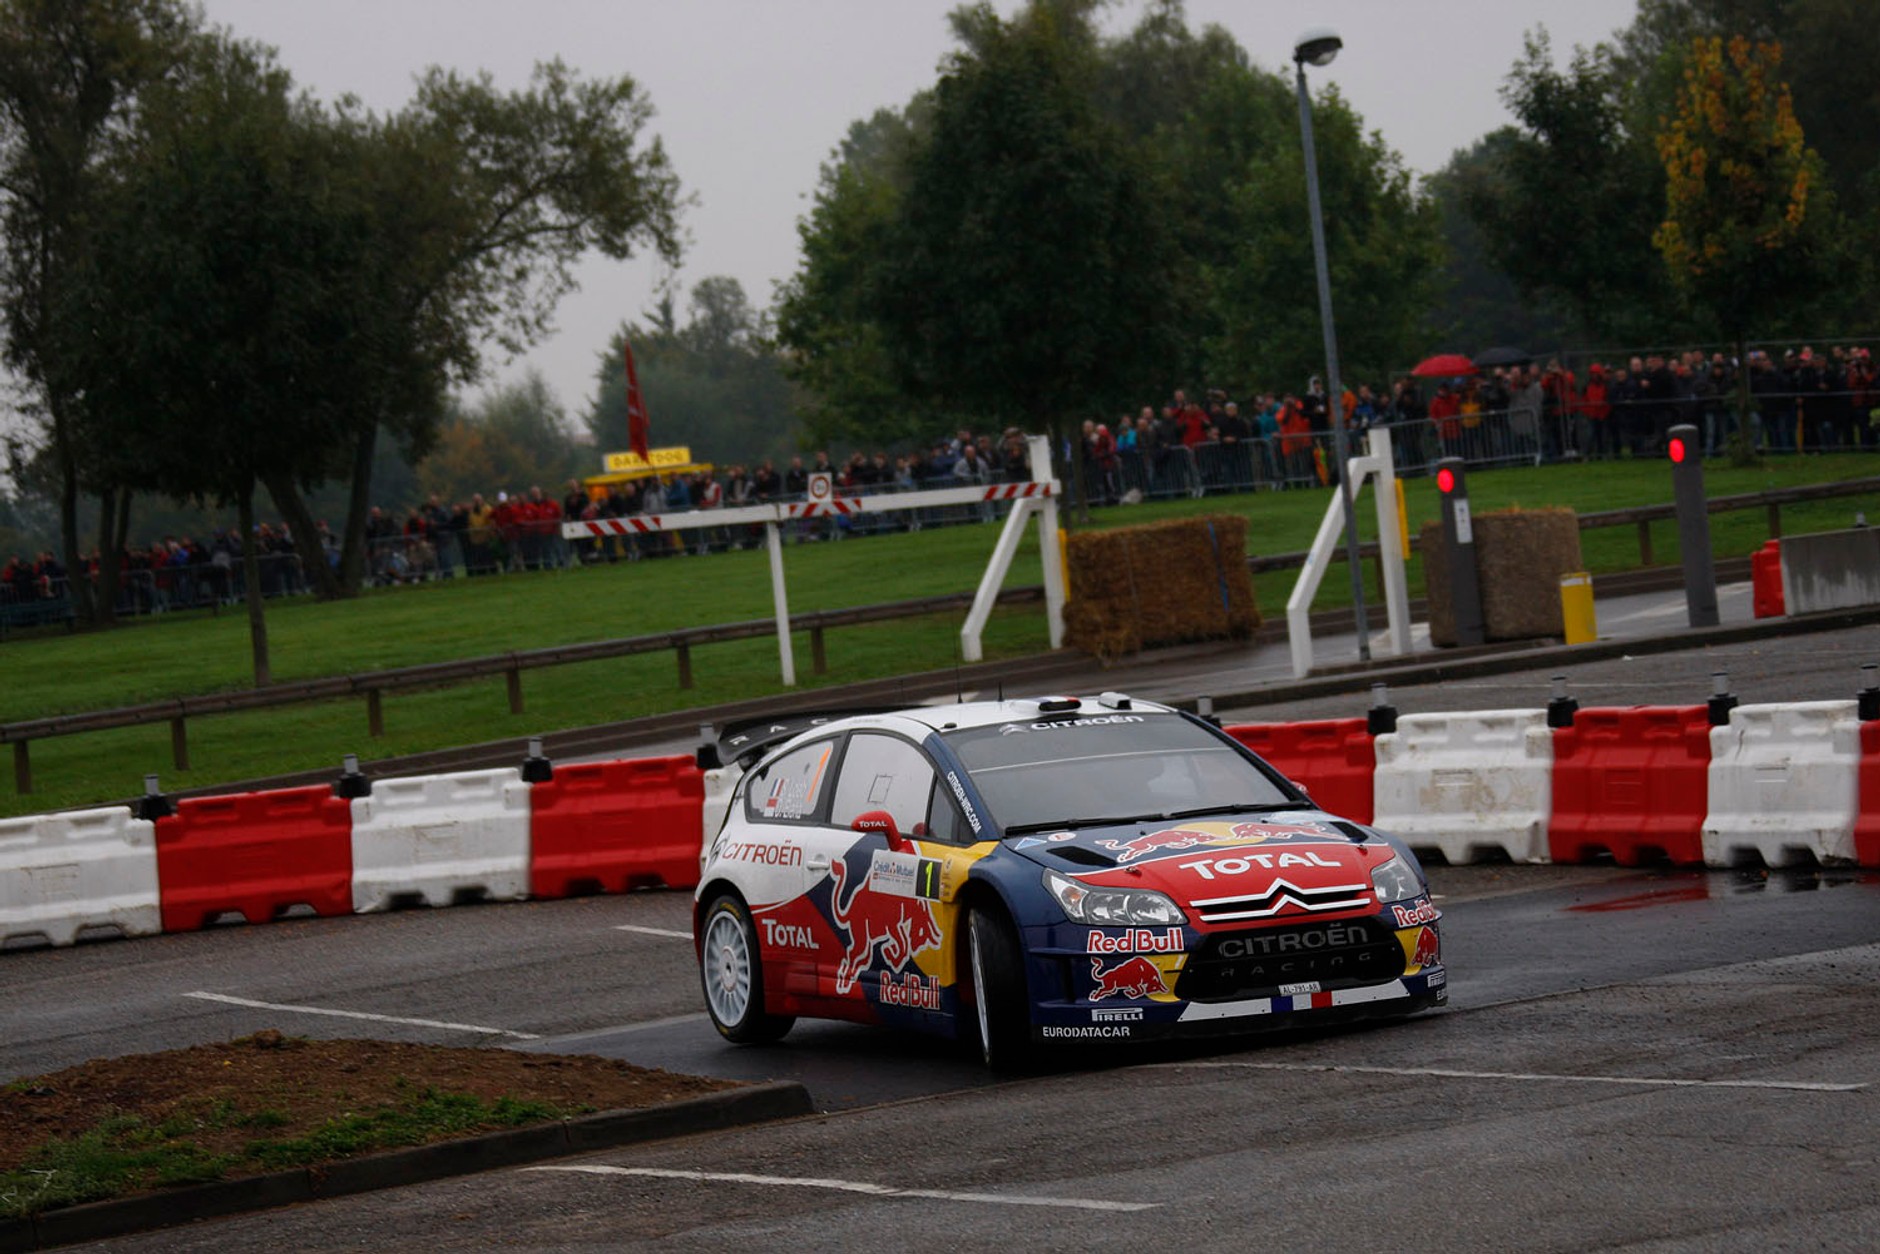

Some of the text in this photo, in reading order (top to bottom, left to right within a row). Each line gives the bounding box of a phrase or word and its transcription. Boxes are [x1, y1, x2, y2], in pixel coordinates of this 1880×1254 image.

[858, 819, 888, 829] TOTAL
[722, 839, 802, 867] CITROËN
[1179, 851, 1342, 881] TOTAL
[925, 861, 934, 898] 1
[762, 918, 820, 950] TOTAL
[1087, 926, 1184, 953] Red Bull
[1218, 922, 1368, 959] CITROËN
[880, 970, 940, 1010] Red Bull
[1091, 1008, 1144, 1022] PIRELLI
[1042, 1025, 1131, 1038] EURODATACAR
